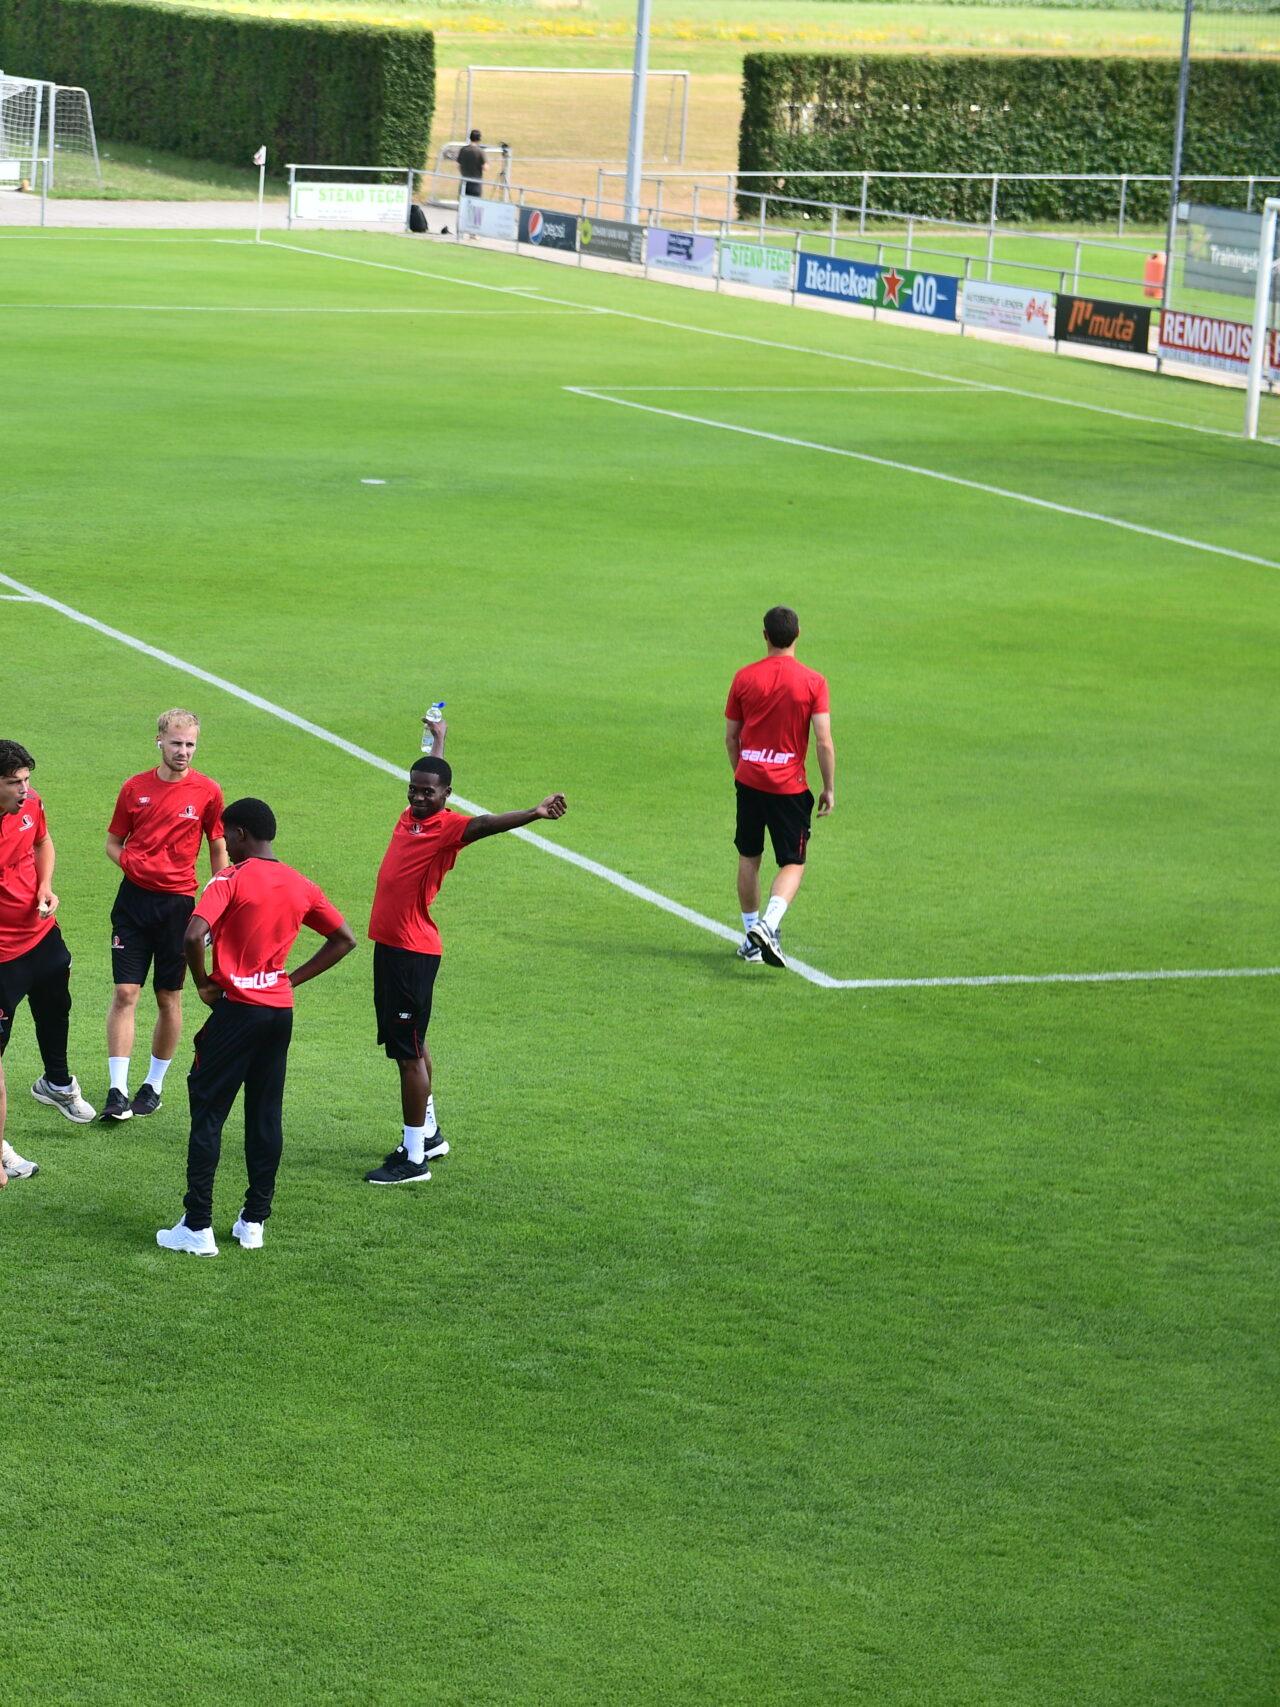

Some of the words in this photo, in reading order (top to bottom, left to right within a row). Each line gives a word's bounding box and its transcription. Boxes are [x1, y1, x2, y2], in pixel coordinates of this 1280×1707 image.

[805, 259, 878, 300] Heineken
[1088, 312, 1135, 342] muta
[1163, 312, 1253, 359] REMONDIS
[741, 748, 795, 764] saller
[230, 969, 286, 989] saller
